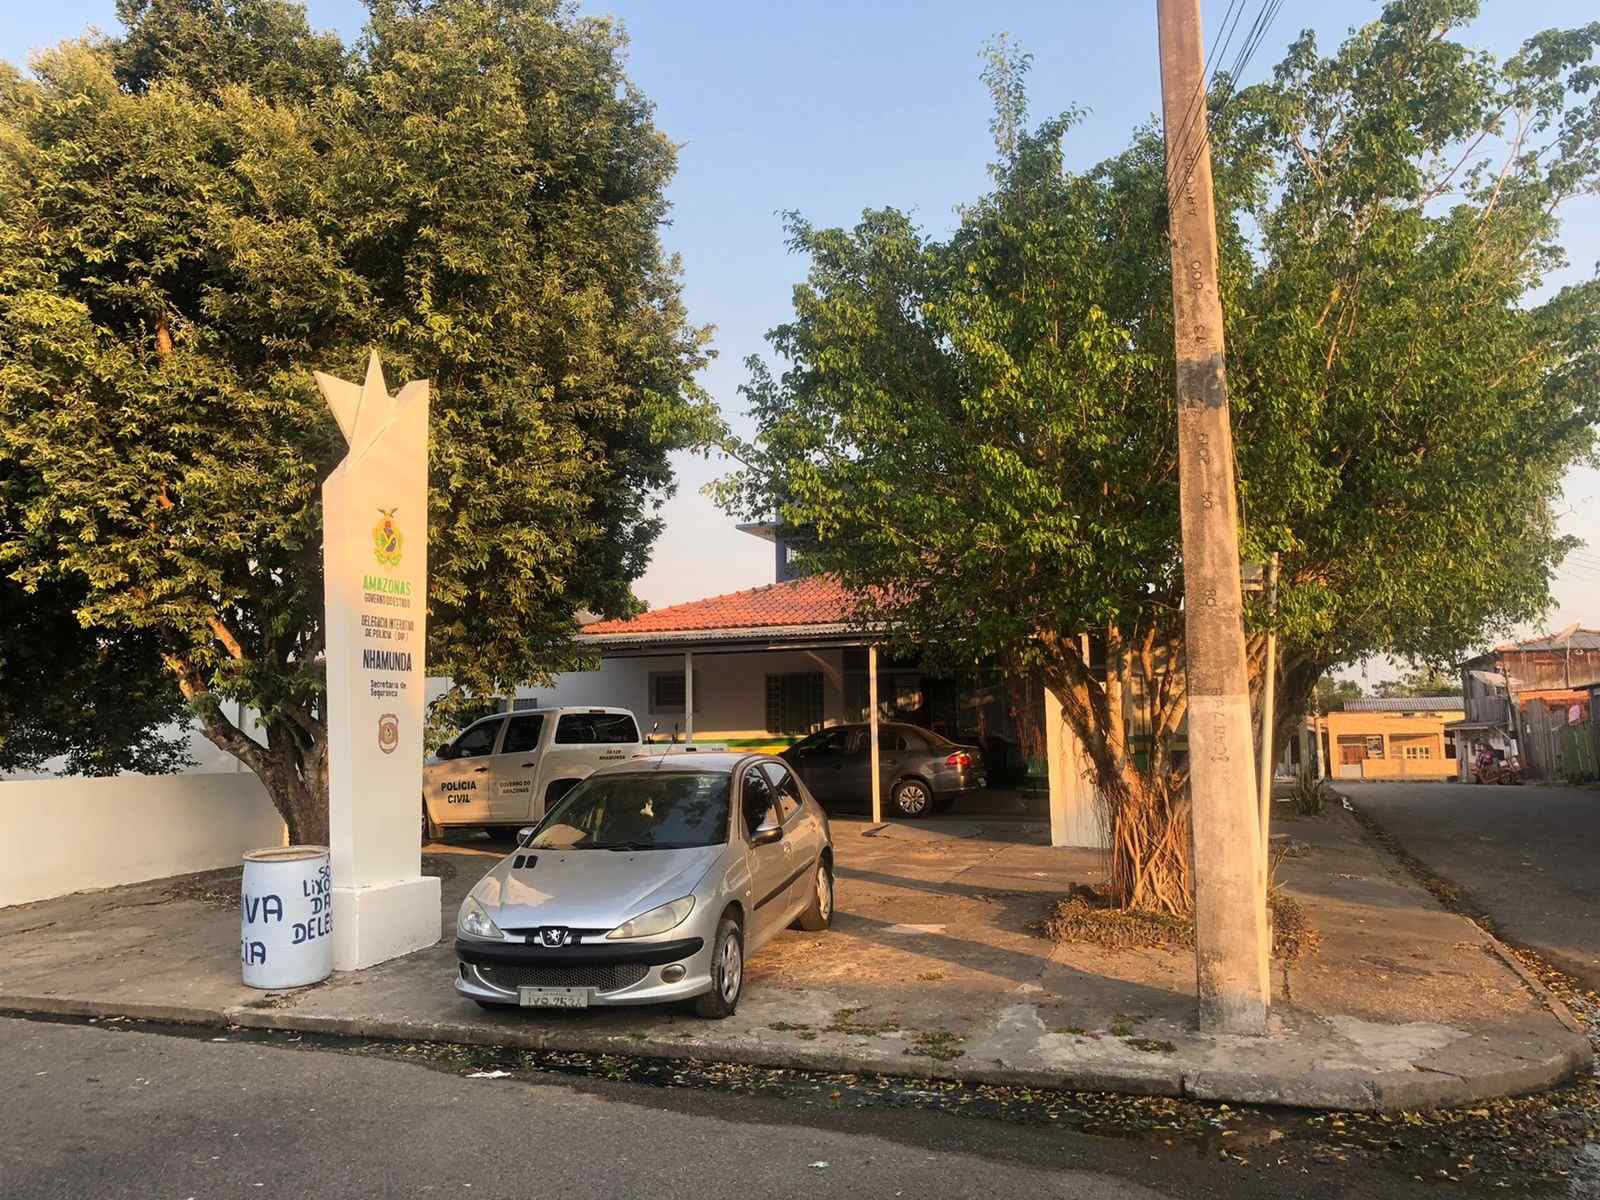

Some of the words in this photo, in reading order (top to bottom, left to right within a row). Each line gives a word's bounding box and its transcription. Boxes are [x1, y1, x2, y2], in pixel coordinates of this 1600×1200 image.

[363, 575, 411, 595] AMAZONAS
[447, 794, 470, 804] CIVIL
[292, 912, 333, 944] DELE
